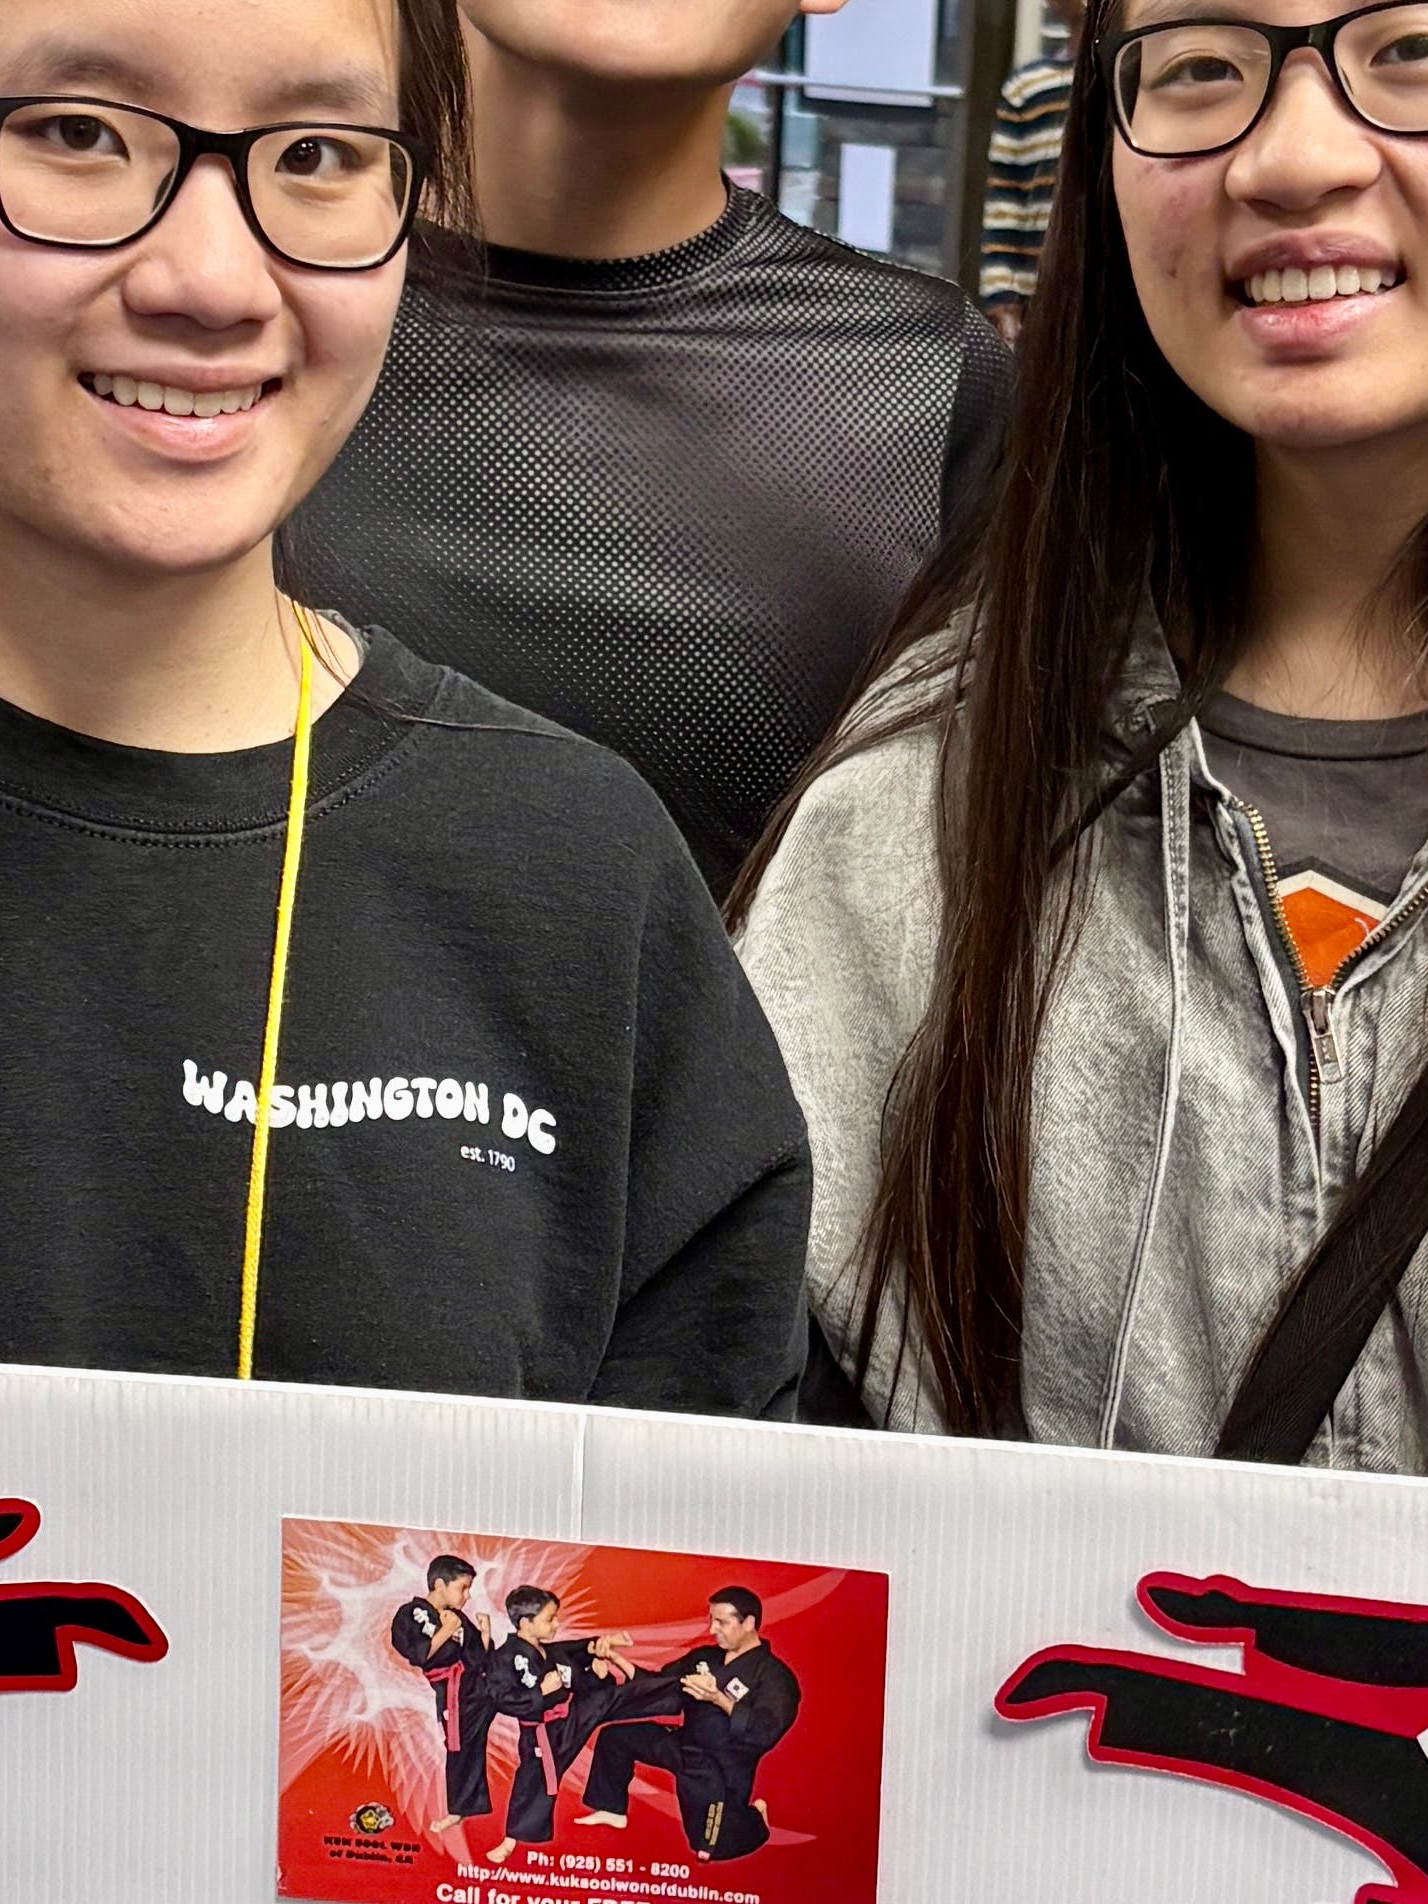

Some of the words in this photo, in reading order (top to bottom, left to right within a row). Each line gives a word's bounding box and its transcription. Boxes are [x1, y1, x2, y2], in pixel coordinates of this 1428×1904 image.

[182, 1058, 490, 1129] WASHINGTON
[502, 1092, 557, 1154] DC
[460, 1146, 485, 1162] est.
[488, 1149, 515, 1172] 1790
[527, 1851, 555, 1867] Ph:
[605, 1858, 634, 1873] 551
[650, 1862, 690, 1879] 8200
